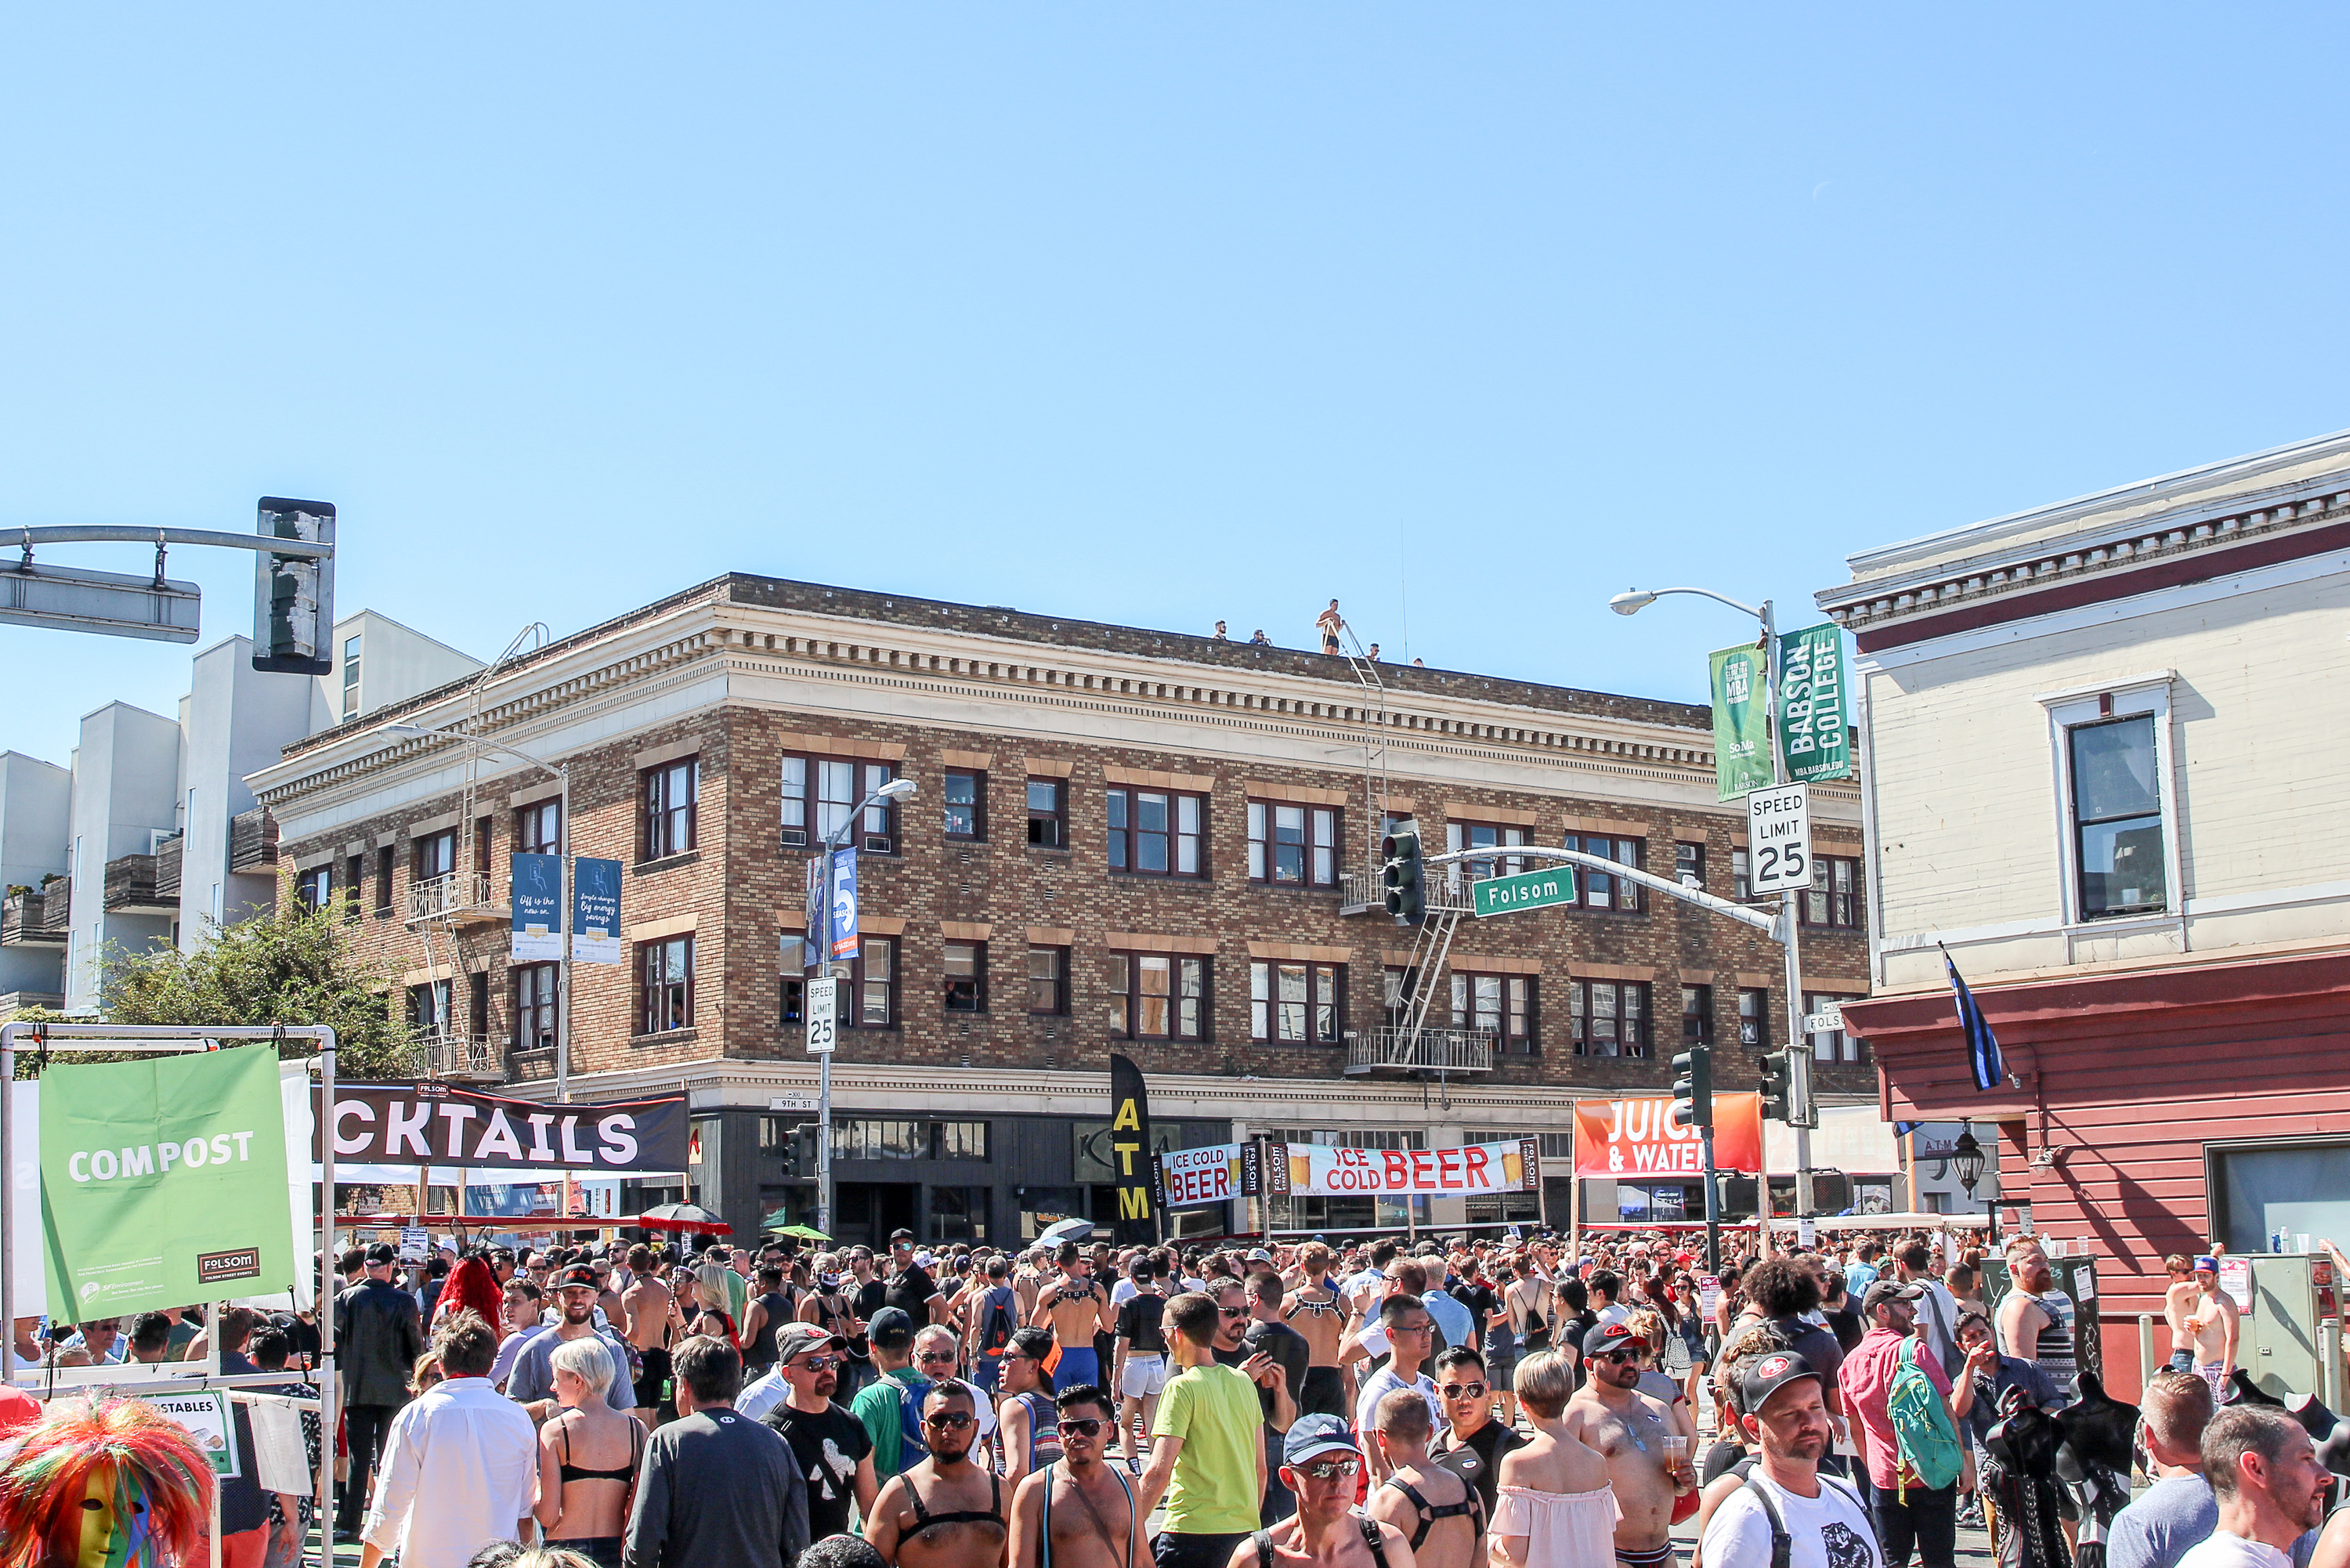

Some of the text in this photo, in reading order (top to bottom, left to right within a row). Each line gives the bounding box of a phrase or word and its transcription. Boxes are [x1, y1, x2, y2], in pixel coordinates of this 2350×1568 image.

[1725, 668, 1738, 677] CLOSE
[1726, 678, 1748, 697] MBA
[1813, 638, 1842, 750] COLLEGE
[1726, 693, 1749, 705] PROGRAM
[1785, 644, 1815, 755] BABSON
[1729, 739, 1755, 754] SoMa
[1795, 760, 1844, 777] MBA.BABSON.EDU
[1734, 779, 1759, 791] BABSON
[1753, 795, 1802, 815] SPEED
[1760, 819, 1799, 839] LIMIT
[1758, 841, 1804, 882] 25
[519, 894, 532, 907] Off
[543, 895, 555, 905] the
[833, 865, 855, 934] 5
[1488, 880, 1558, 906] Folsom
[580, 901, 616, 916] Big energy
[833, 909, 852, 919] SEASON
[834, 939, 855, 952] SFJAZZ.org
[810, 986, 833, 999] SPEED
[813, 1003, 831, 1015] LIMIT
[811, 1019, 832, 1044] 25
[312, 1099, 638, 1165] CKTAILS
[68, 1130, 254, 1183] COMPOST
[1173, 1150, 1224, 1169] ICE COLD
[1333, 1148, 1369, 1166] ICE
[1608, 1145, 1624, 1172] &
[1272, 1147, 1282, 1190] FOLSOM
[1326, 1147, 1491, 1190] COLD BEER
[1153, 1161, 1162, 1202] FOLSOM
[1172, 1167, 1228, 1202] BEER
[204, 1255, 252, 1270] FOLSOM
[1315, 1428, 1337, 1436] adidas
